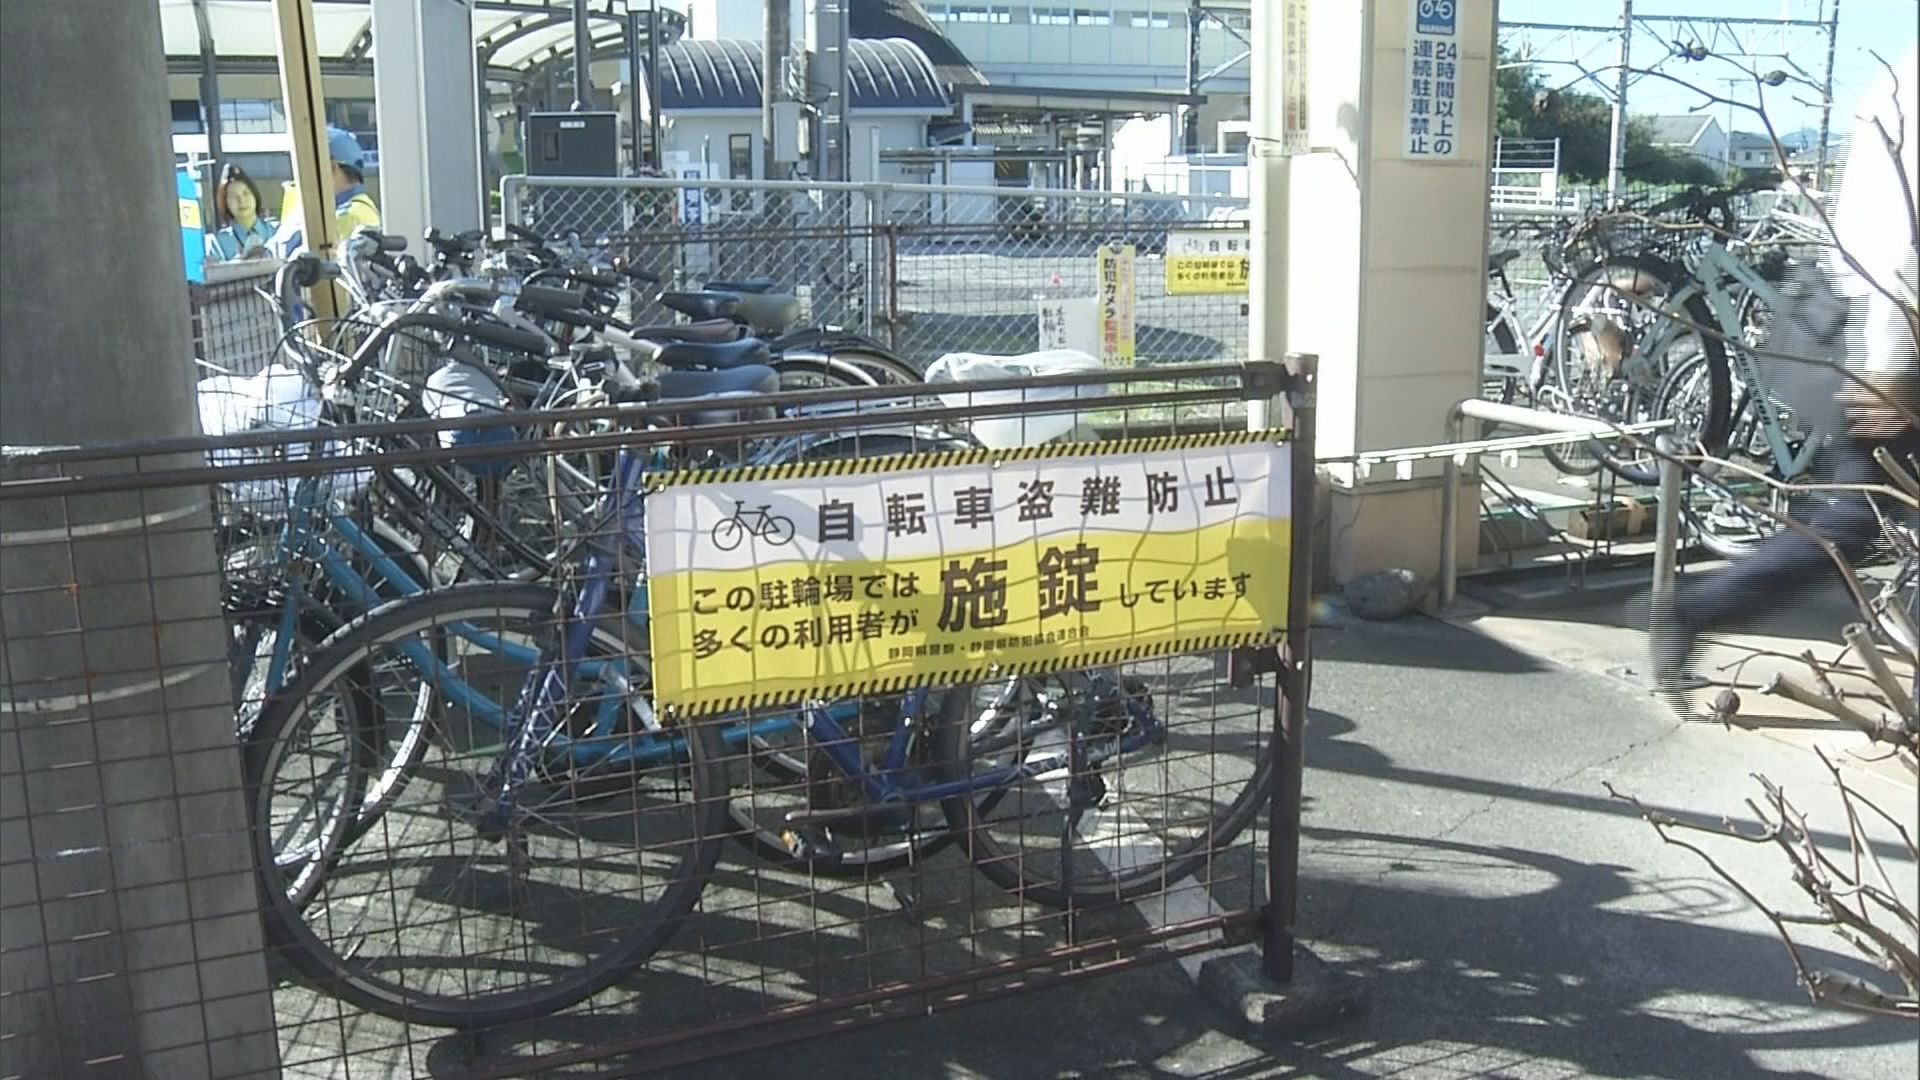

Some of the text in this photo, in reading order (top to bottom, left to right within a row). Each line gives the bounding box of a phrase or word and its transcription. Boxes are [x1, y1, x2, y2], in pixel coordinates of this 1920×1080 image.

[1410, 40, 1432, 155] 連続駐車禁止
[1433, 42, 1456, 155] 24時間以上の
[817, 466, 1238, 544] 自転車盗難防止
[693, 572, 919, 615] この駐輪場では
[937, 543, 1251, 632] 施錠 しています
[693, 609, 918, 660] 多くの利用者が
